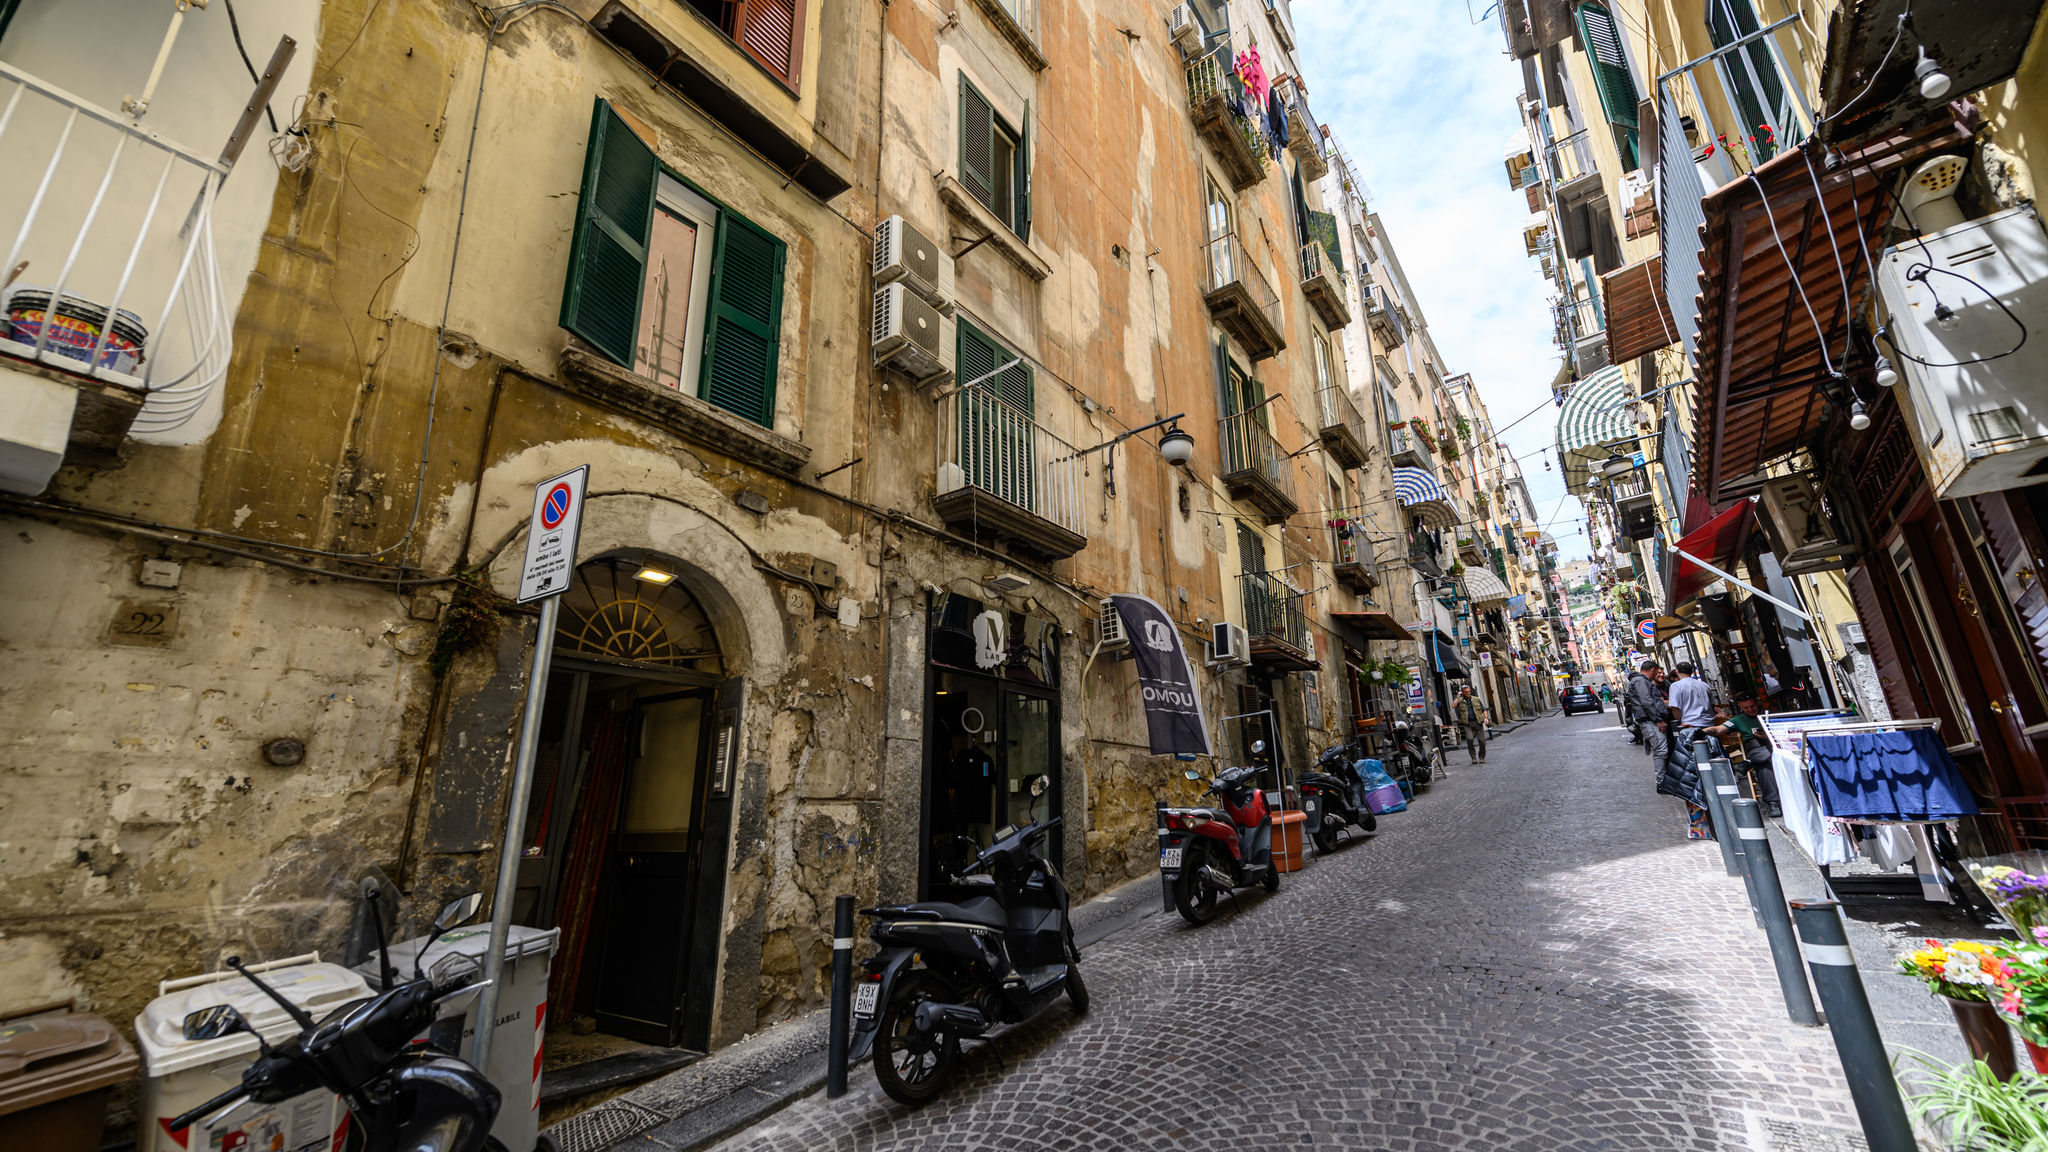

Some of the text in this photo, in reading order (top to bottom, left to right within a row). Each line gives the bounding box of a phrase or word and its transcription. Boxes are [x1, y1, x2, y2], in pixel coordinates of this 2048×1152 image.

[125, 611, 164, 635] 22
[985, 651, 1000, 661] LAB
[859, 985, 876, 998] X9X
[495, 1010, 521, 1027] LABILE
